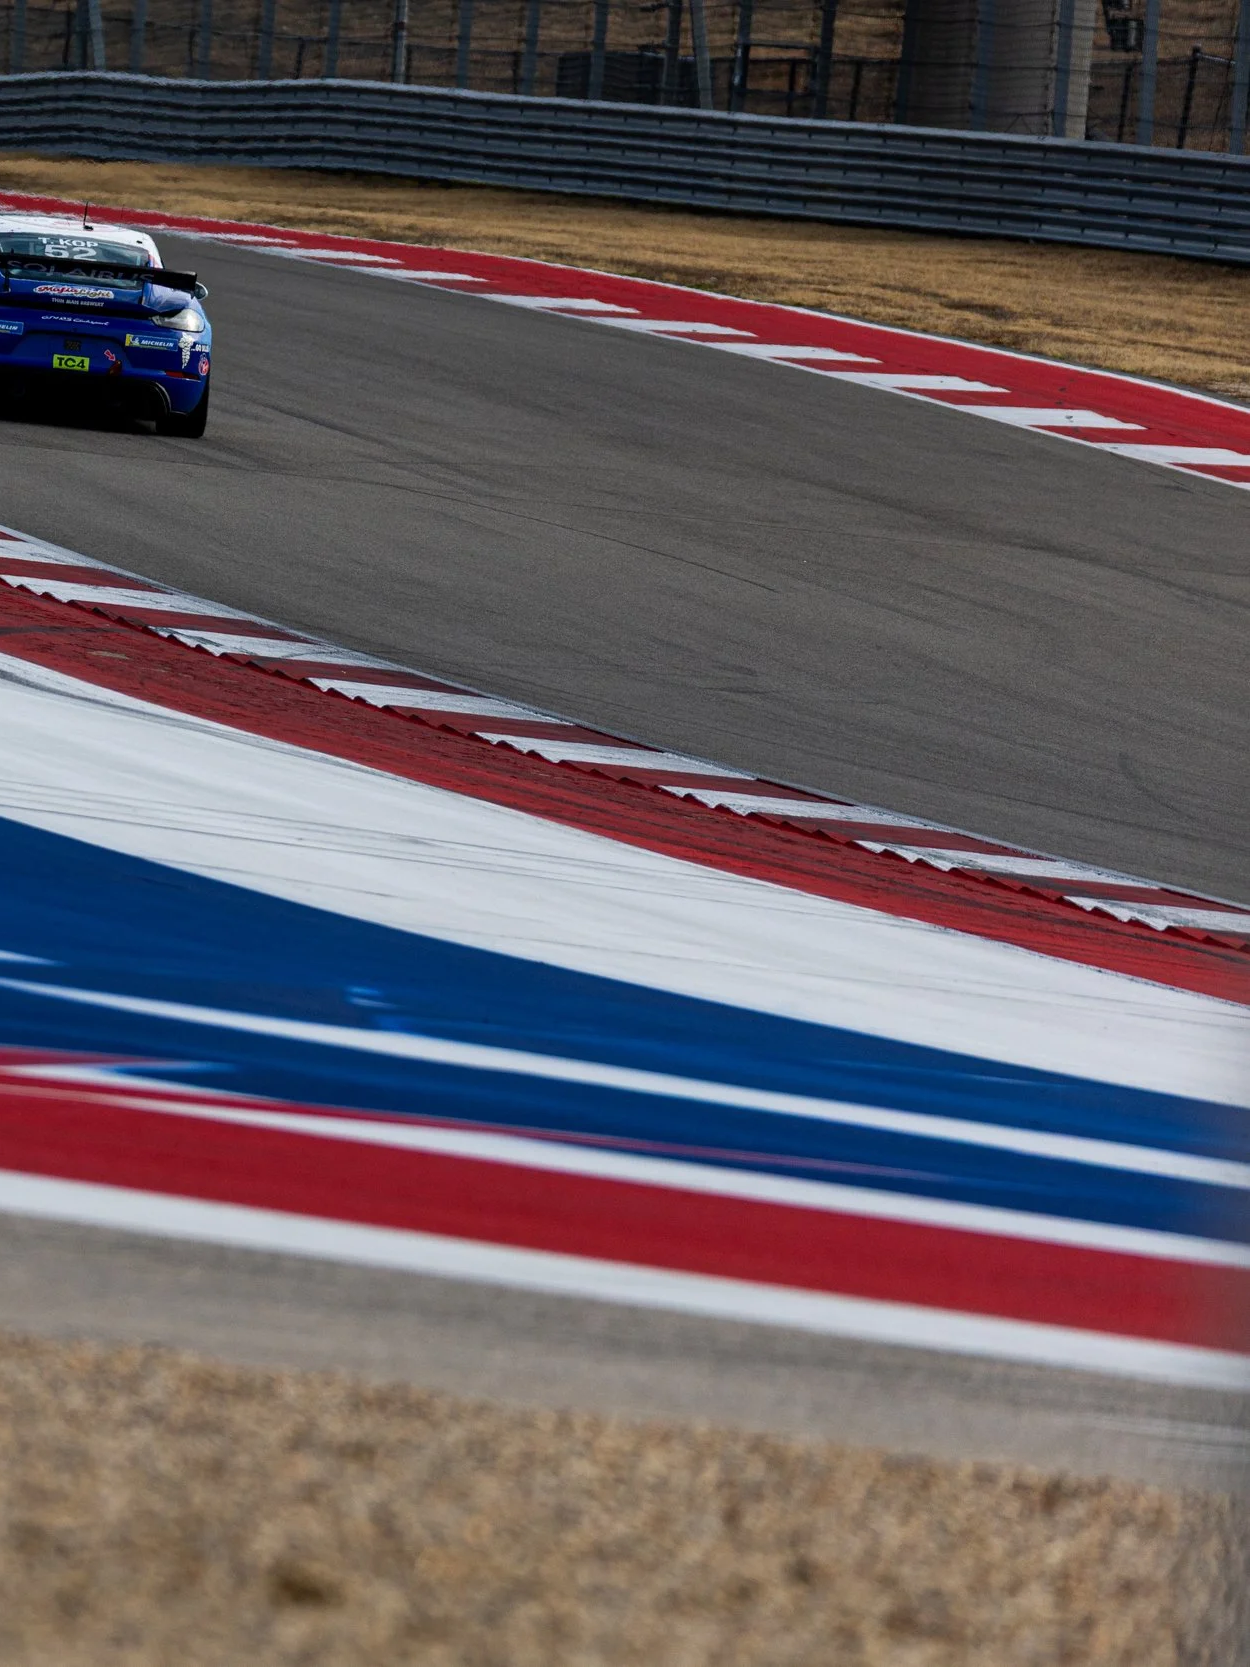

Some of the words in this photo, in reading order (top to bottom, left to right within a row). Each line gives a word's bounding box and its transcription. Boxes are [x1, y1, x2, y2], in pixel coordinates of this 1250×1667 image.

[59, 238, 99, 247] KOP
[44, 244, 98, 261] 52
[140, 339, 175, 348] MICHELIN
[57, 357, 85, 368] TC4
